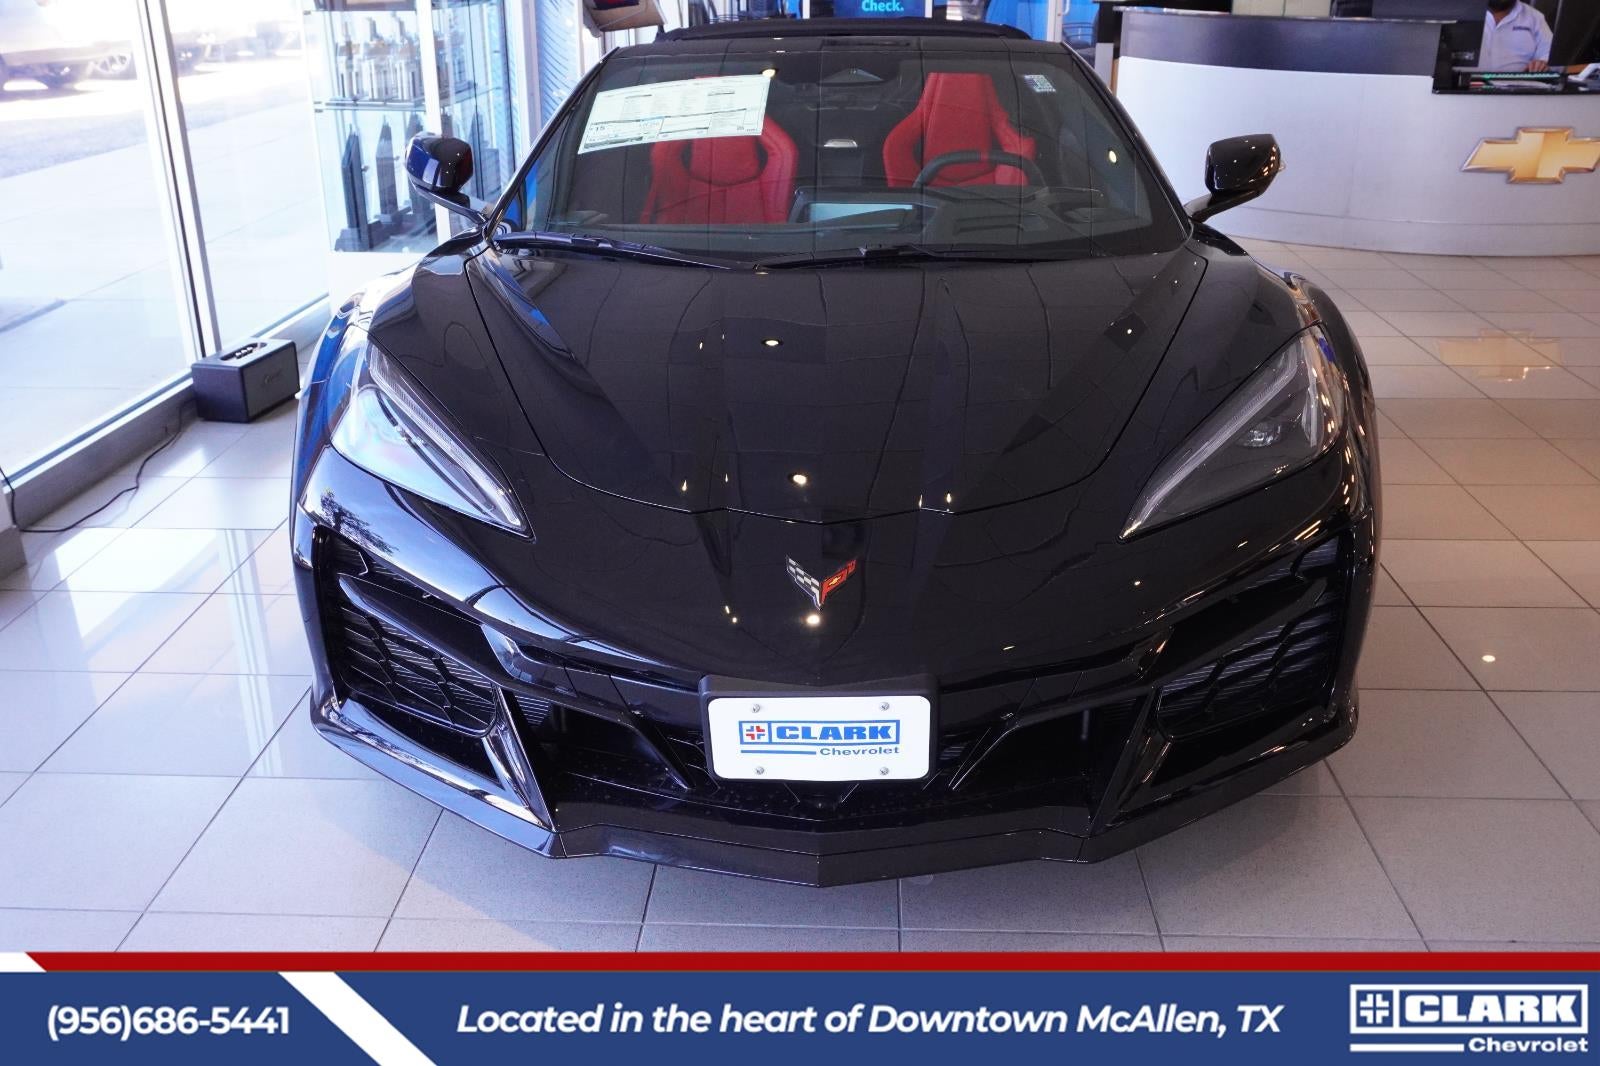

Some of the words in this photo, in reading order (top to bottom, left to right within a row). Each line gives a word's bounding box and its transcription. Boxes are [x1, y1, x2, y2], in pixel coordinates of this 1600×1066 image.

[861, 0, 904, 12] Check.
[776, 725, 893, 741] CLARK
[819, 746, 900, 757] Chevrolet
